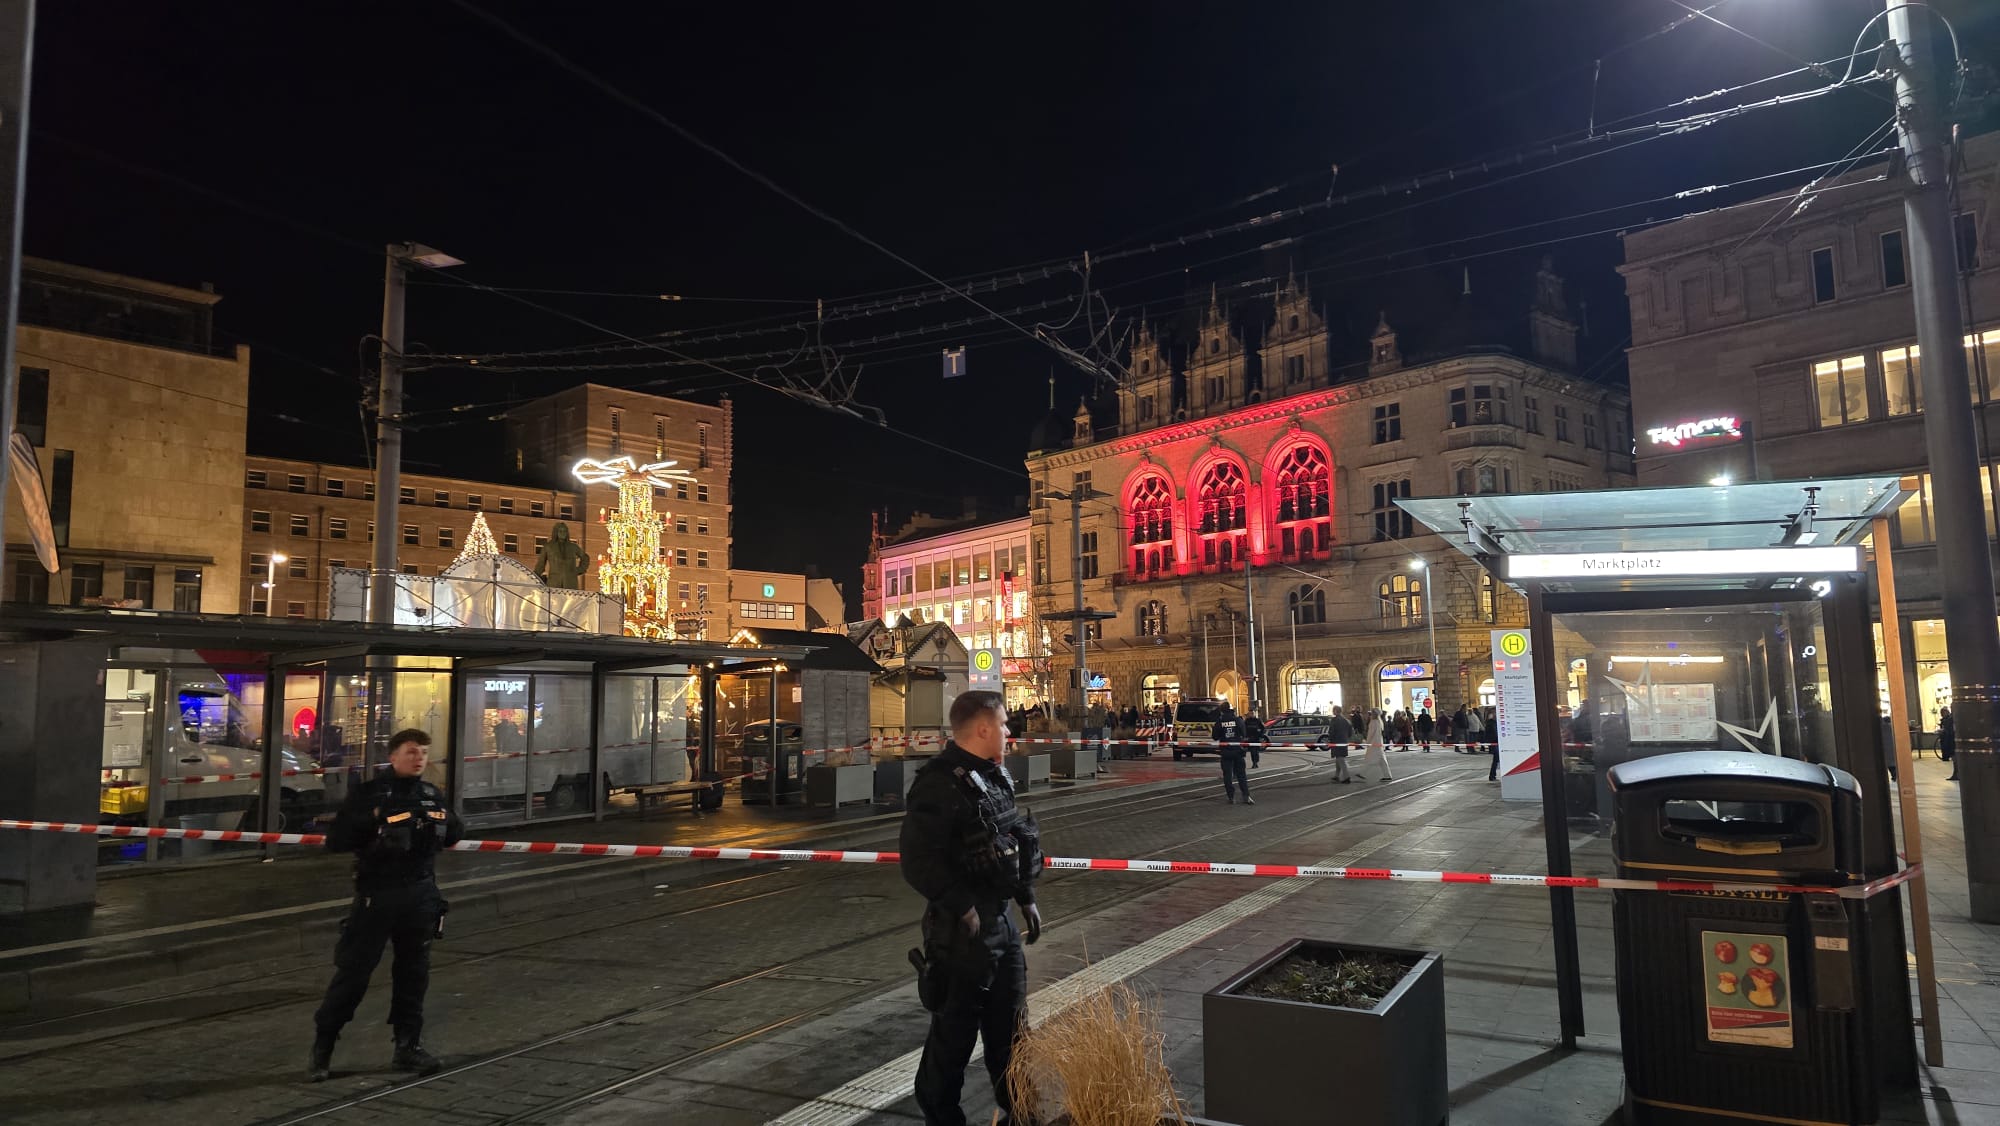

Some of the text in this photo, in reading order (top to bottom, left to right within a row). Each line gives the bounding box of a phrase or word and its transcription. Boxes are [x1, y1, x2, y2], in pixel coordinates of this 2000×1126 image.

[947, 352, 961, 375] T
[1582, 557, 1661, 571] Marktplatz
[1508, 638, 1520, 651] H
